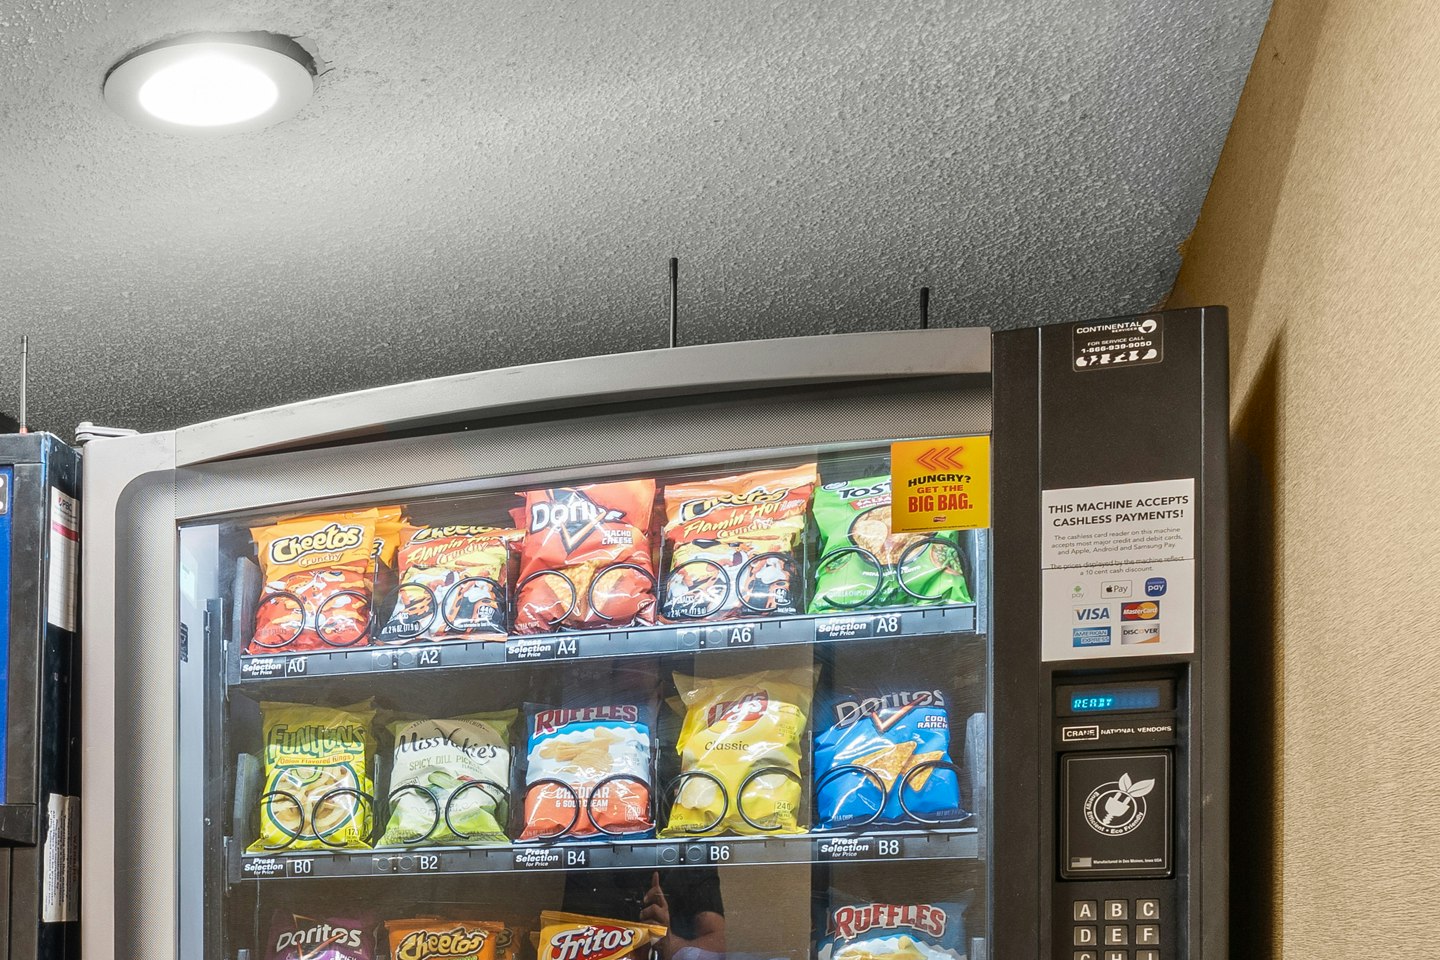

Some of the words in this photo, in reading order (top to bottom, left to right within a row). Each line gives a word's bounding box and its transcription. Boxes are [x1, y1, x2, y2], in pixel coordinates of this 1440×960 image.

[1076, 321, 1141, 334] CONTINENTAL
[908, 474, 971, 487] HUNGRY?
[917, 486, 939, 494] GET
[942, 484, 964, 492] THE
[908, 495, 934, 513] BIG
[937, 493, 973, 511] BAG.
[1048, 504, 1073, 514] THIS
[1076, 500, 1133, 512] MACHINE
[1136, 495, 1189, 508] ACCEPTS
[1053, 514, 1112, 527] CASHLESS
[1115, 509, 1184, 523] PAYMENTS!
[271, 523, 362, 563] Cheetos
[1051, 541, 1075, 549] accepts
[1093, 539, 1111, 547] major
[1146, 534, 1163, 542] debit
[1067, 532, 1093, 540] cashless
[1093, 545, 1119, 553] Android
[1133, 542, 1162, 551] Samsung
[298, 553, 343, 567] Crunchy
[1114, 585, 1128, 593] Pay
[1147, 584, 1164, 592] pay
[1075, 607, 1110, 620] VISA
[1123, 607, 1157, 615] MasterCard
[876, 617, 898, 632] A8
[731, 627, 752, 643] A6
[1123, 628, 1158, 636] DISCOVER
[557, 639, 576, 655] A4
[420, 652, 438, 665] A2
[836, 689, 944, 727] Doritos
[1073, 697, 1112, 709] READY
[534, 705, 638, 739] RUFFLES
[917, 721, 948, 730] RANCH
[924, 715, 948, 724] COOL
[1066, 729, 1095, 738] CRANE
[395, 732, 439, 760] Miss
[704, 740, 749, 751] Classic
[302, 756, 331, 764] Flavored
[332, 753, 351, 763] Rings
[711, 846, 729, 861] B6
[879, 840, 900, 855] B8
[421, 856, 439, 869] B2
[567, 850, 586, 865] B4
[1079, 904, 1091, 918] A
[1111, 903, 1122, 917] B
[1143, 902, 1154, 917] C
[835, 903, 947, 938] RUFFLES
[276, 923, 362, 952] Doritos
[1080, 929, 1091, 943] D
[1112, 928, 1122, 942] E
[1143, 928, 1153, 942] F
